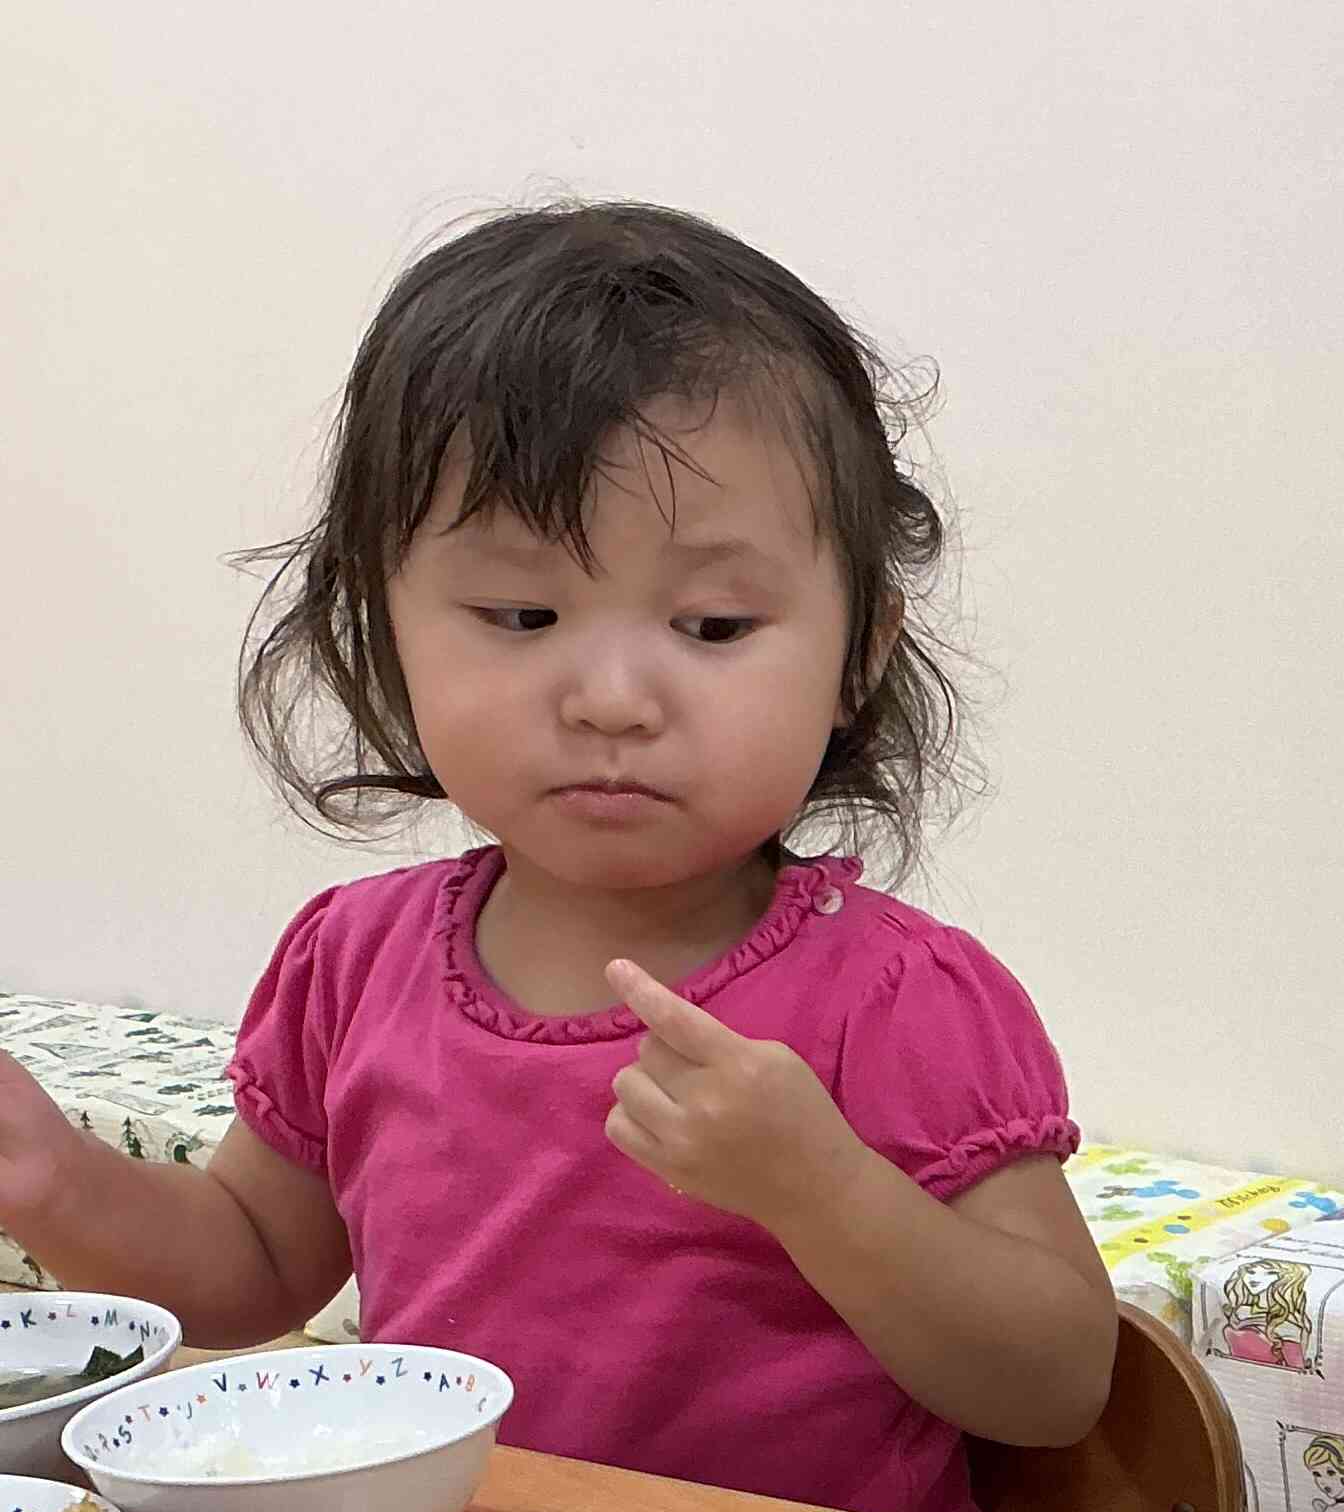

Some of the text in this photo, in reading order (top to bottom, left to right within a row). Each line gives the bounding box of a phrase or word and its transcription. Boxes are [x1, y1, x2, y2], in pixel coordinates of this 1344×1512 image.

[20, 1309, 37, 1328] K
[104, 1309, 118, 1327] M
[137, 1404, 150, 1421] T
[213, 1373, 226, 1392] V
[256, 1372, 279, 1389] W
[309, 1365, 329, 1386] X
[392, 1357, 408, 1378] Z
[439, 1374, 450, 1392] A
